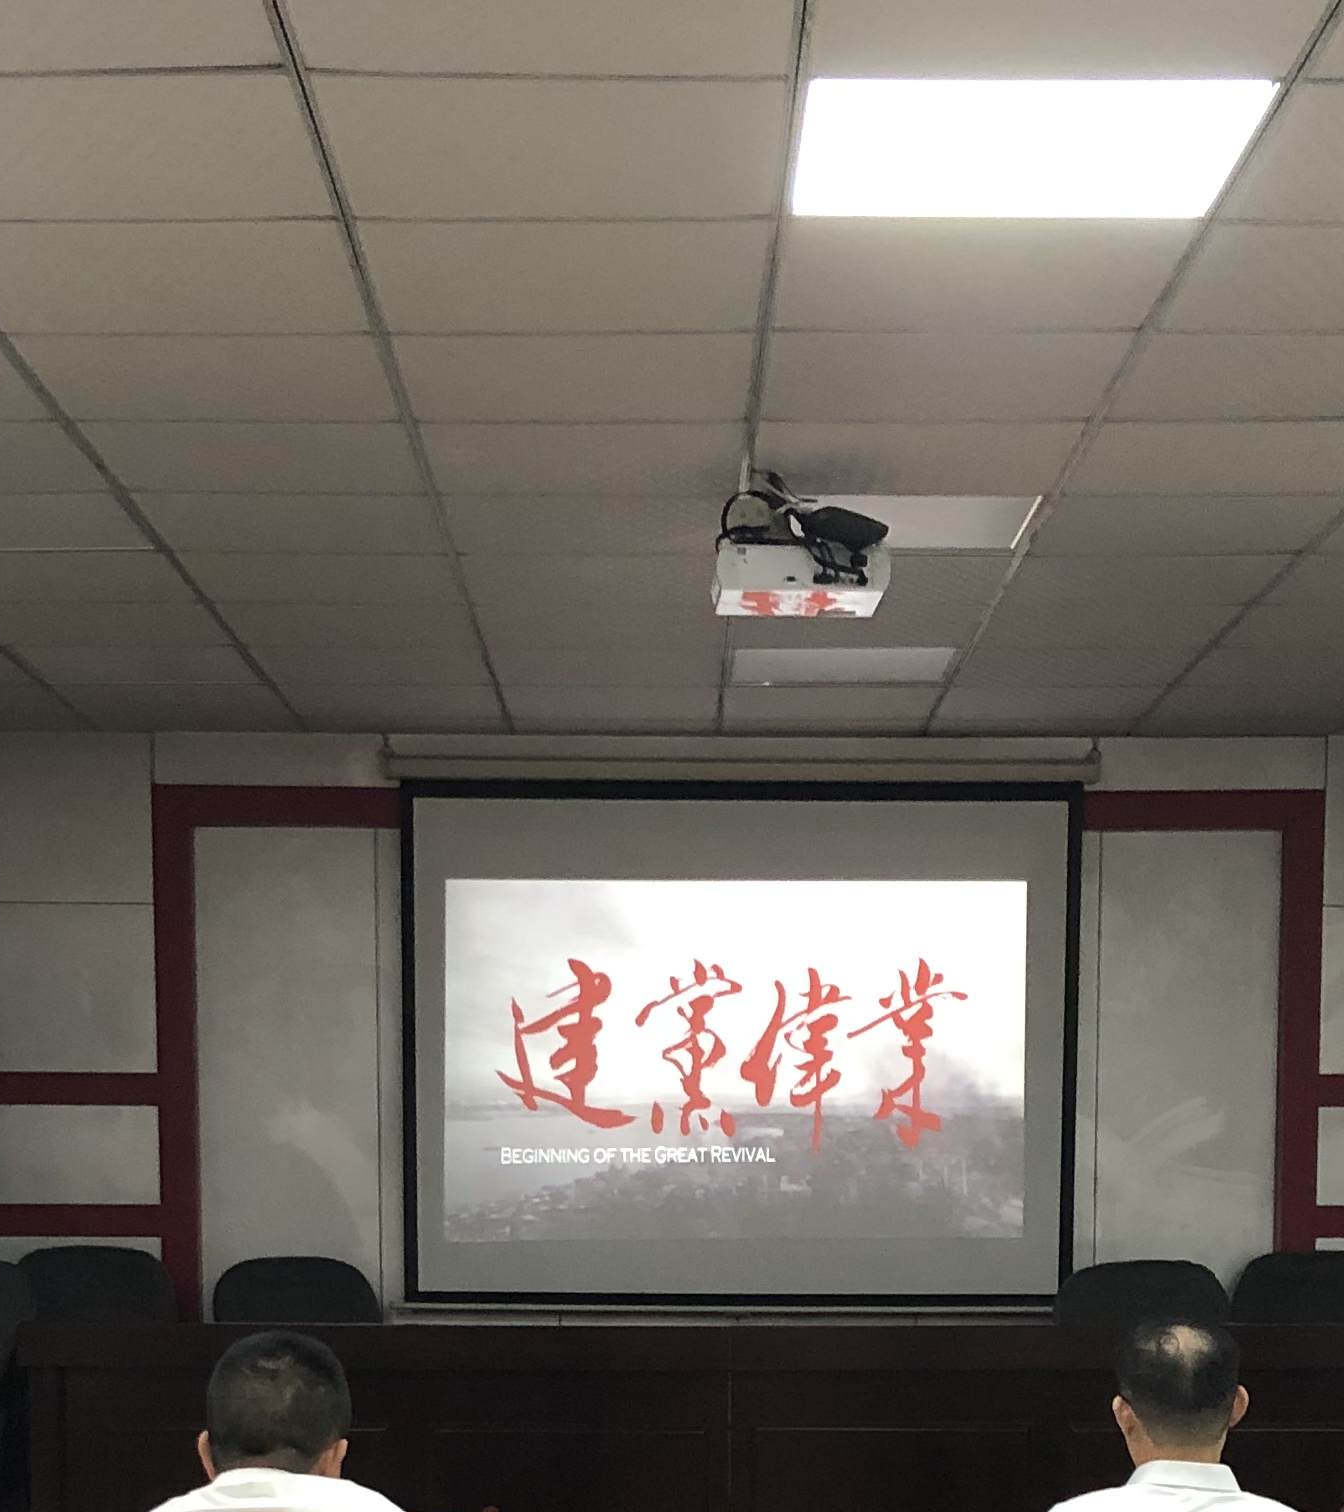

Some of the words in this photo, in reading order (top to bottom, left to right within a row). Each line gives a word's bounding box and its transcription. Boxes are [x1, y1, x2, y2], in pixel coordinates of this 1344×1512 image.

[500, 1146, 590, 1164] BEGINNING
[593, 1147, 616, 1164] OF
[619, 1147, 652, 1164] THE
[654, 1146, 708, 1165] GREAT
[711, 1146, 776, 1164] REVIVAL
